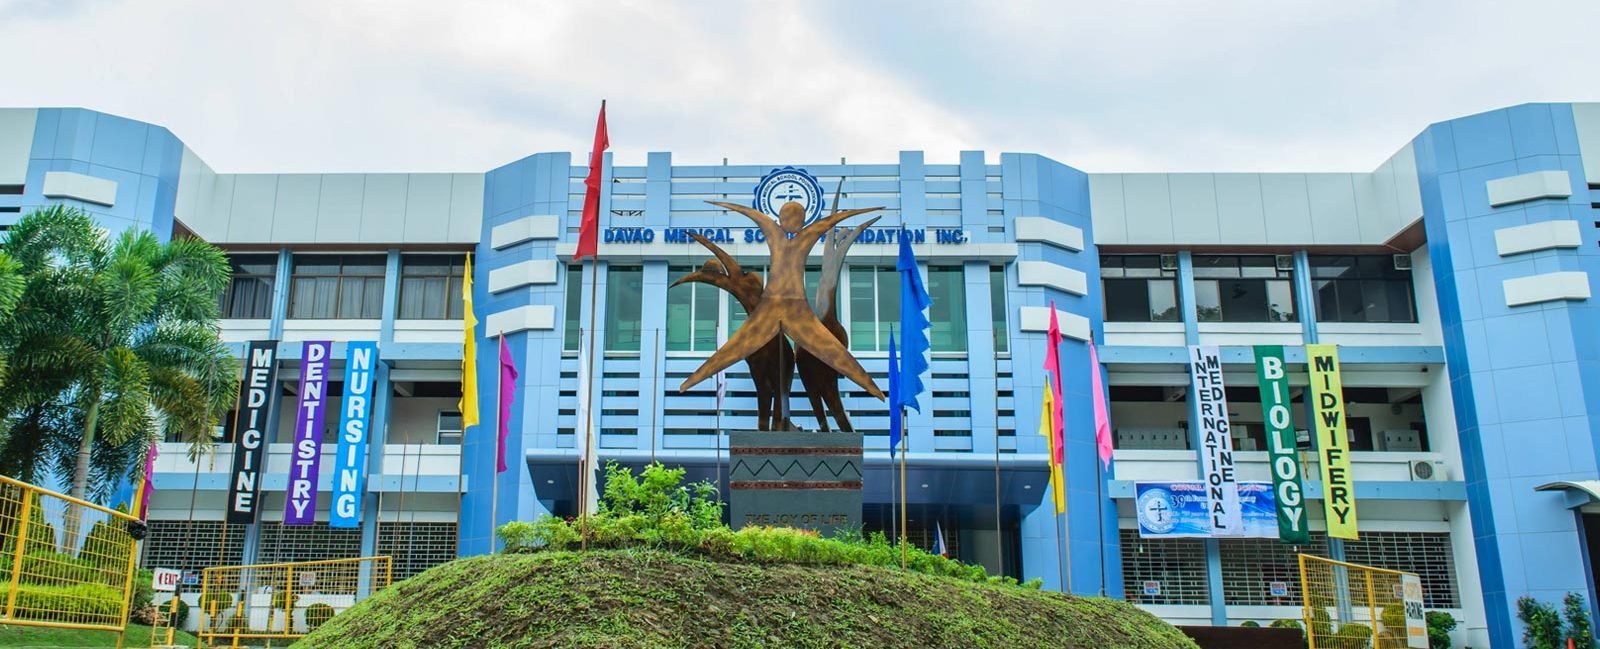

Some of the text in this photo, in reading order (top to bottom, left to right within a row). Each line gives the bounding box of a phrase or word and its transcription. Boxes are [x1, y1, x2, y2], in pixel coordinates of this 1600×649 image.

[604, 228, 655, 243] DAVAO
[819, 228, 926, 243] NDATION
[234, 348, 272, 512] MEDICINE
[292, 344, 325, 518] DENTISTRY
[336, 348, 371, 518] NURSING
[1195, 348, 1226, 529] INTERNATIONAL
[1206, 356, 1234, 483] MEDICINE
[1262, 356, 1303, 531] BIOLOGY
[1314, 356, 1350, 524] MIDWIFERY
[745, 514, 848, 525] THE JOY OF LIFE
